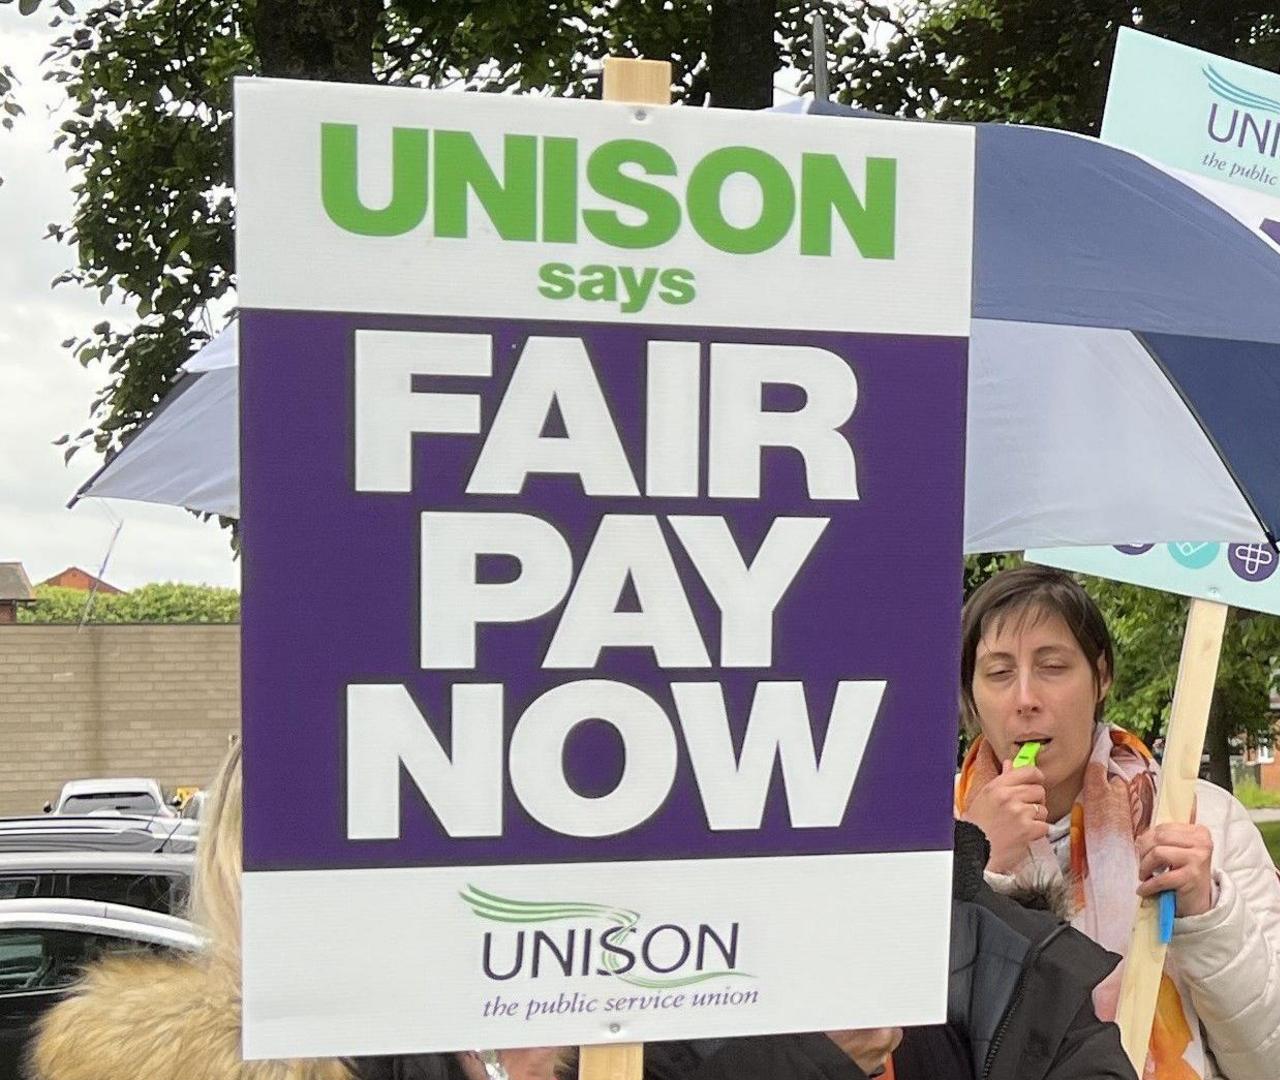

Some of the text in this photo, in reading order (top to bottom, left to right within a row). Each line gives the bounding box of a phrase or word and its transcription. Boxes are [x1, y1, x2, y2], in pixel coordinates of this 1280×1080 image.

[321, 123, 897, 259] UNISON
[1202, 151, 1227, 170] the
[1229, 162, 1277, 186] public
[537, 264, 696, 313] says
[354, 329, 860, 500] FAIR
[421, 511, 831, 669] PAY
[347, 679, 887, 840] NOW
[483, 922, 739, 980] UNISON
[483, 986, 759, 1020] the public service union
